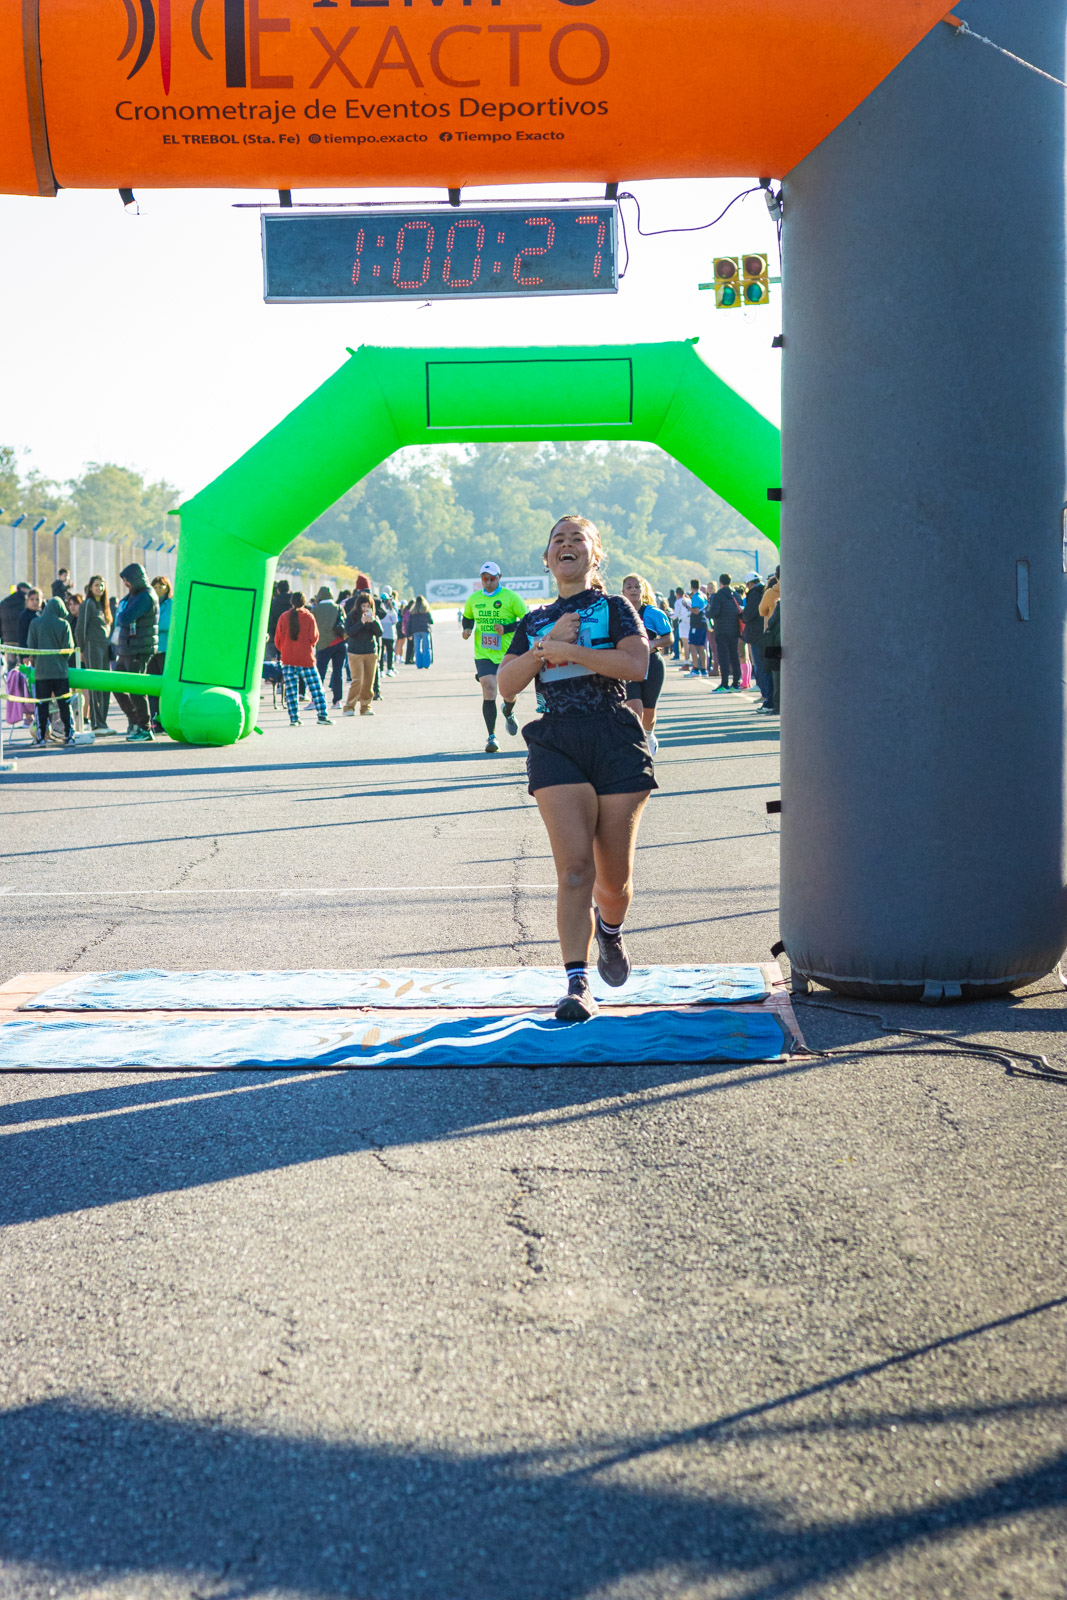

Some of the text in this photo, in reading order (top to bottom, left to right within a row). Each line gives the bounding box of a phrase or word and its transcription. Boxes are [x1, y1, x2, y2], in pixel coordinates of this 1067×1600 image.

[249, 0, 610, 89] EXACTO
[116, 97, 608, 123] Cronometraje de Eventos Deportivos
[163, 133, 301, 145] EL TREBOL (Sta. Fe)
[324, 133, 428, 146] tiempo.exacto
[455, 130, 565, 143] Tiempo Exacto
[351, 215, 606, 289] 1:00:27
[436, 584, 461, 595] Ford
[483, 636, 498, 646] 354
